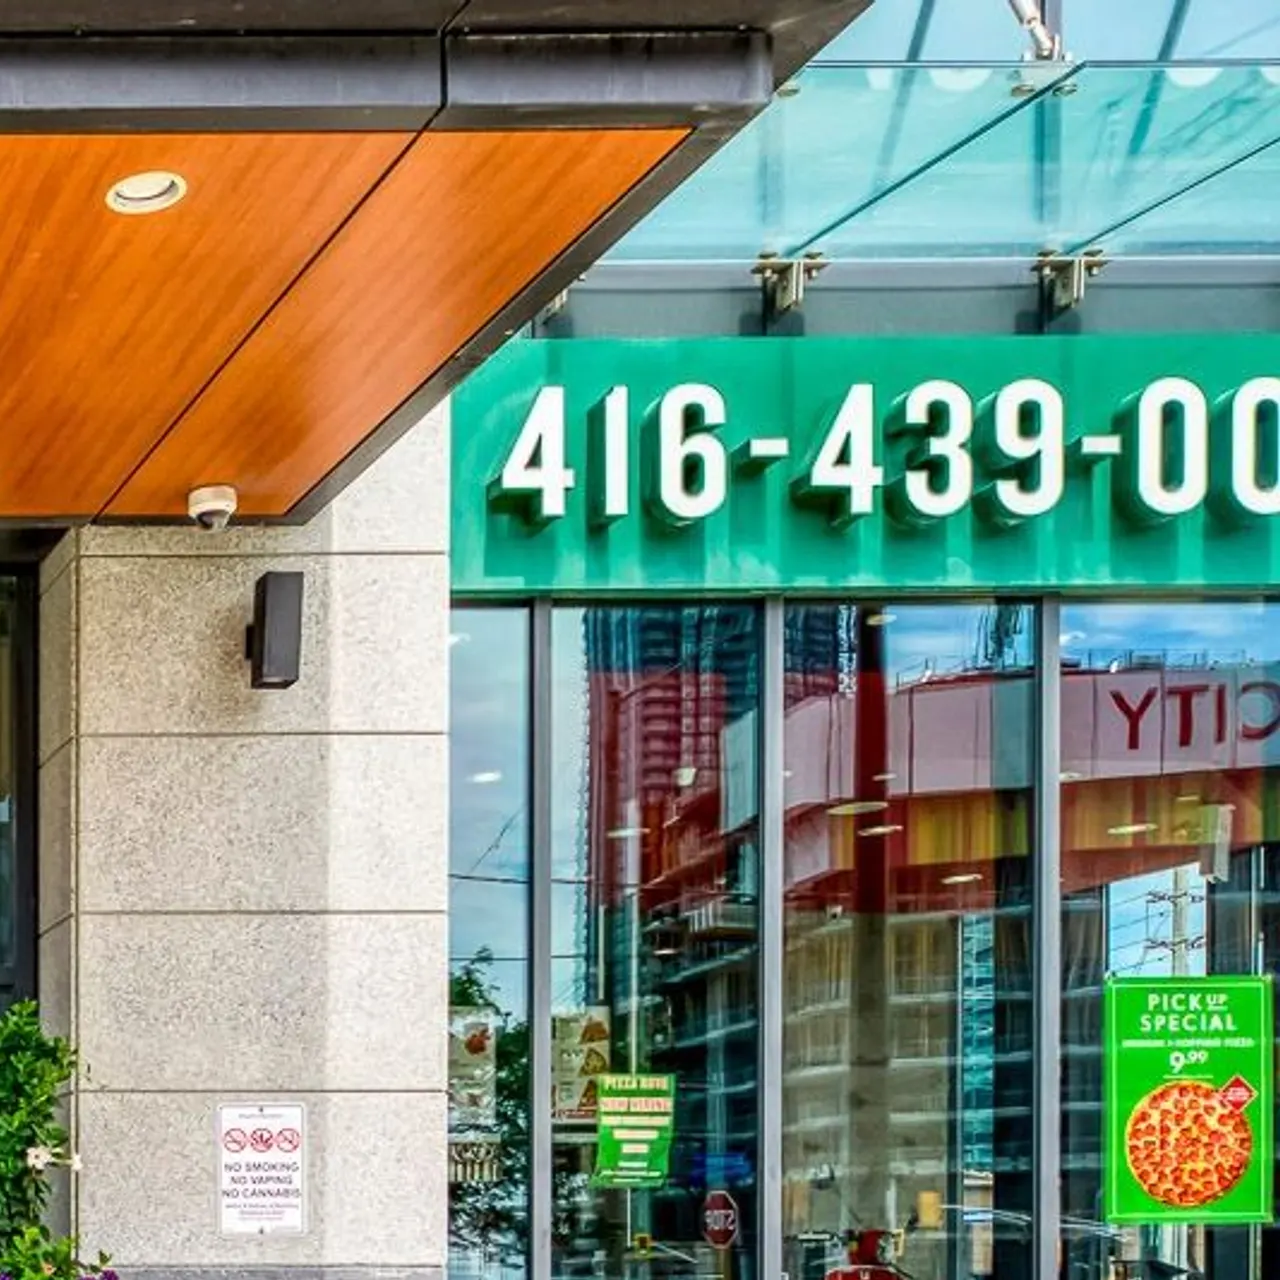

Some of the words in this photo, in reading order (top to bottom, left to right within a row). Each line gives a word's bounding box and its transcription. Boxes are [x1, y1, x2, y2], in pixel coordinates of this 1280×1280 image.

[1148, 993, 1203, 1012] PICK
[1206, 993, 1229, 1006] UP
[1139, 1013, 1238, 1031] SPECIAL
[224, 1161, 242, 1172] NO
[245, 1161, 300, 1172] SMOKING
[231, 1175, 248, 1185] NO
[250, 1175, 293, 1185] VAPING
[222, 1188, 239, 1199] NO
[242, 1187, 302, 1199] CANNABIS
